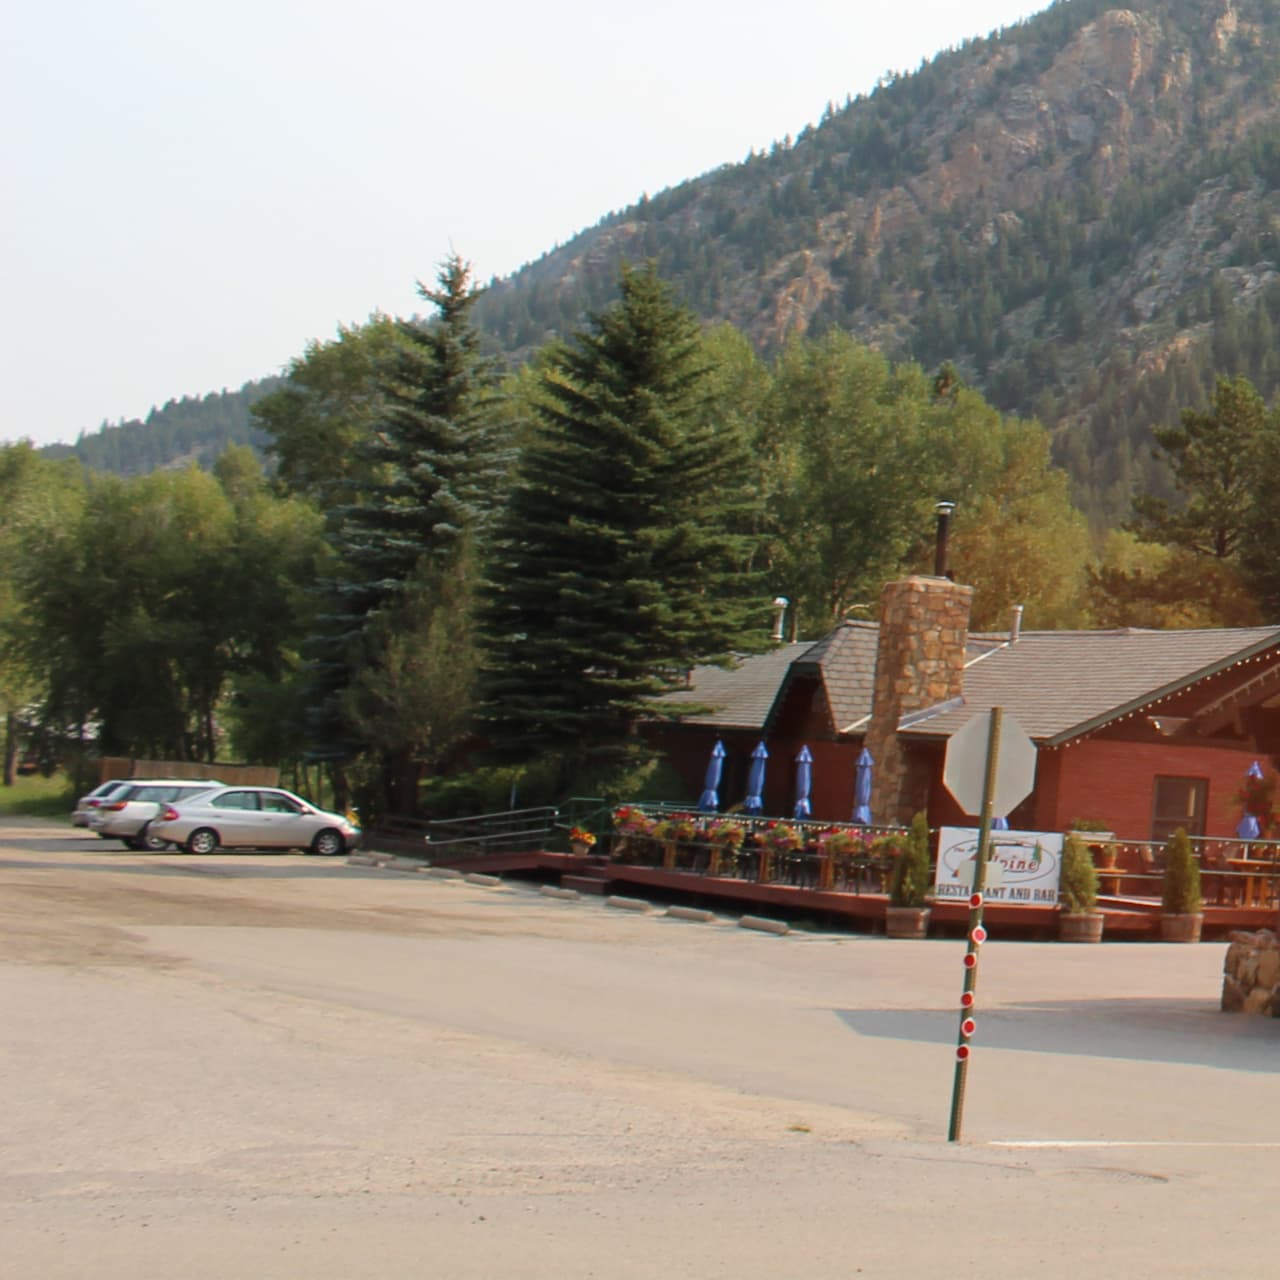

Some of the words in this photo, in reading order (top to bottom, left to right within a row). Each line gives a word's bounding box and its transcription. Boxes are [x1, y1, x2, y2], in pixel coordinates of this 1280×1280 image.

[937, 884, 1007, 900] RESTAANT
[1008, 887, 1031, 901] AND
[1033, 888, 1056, 902] BAR
